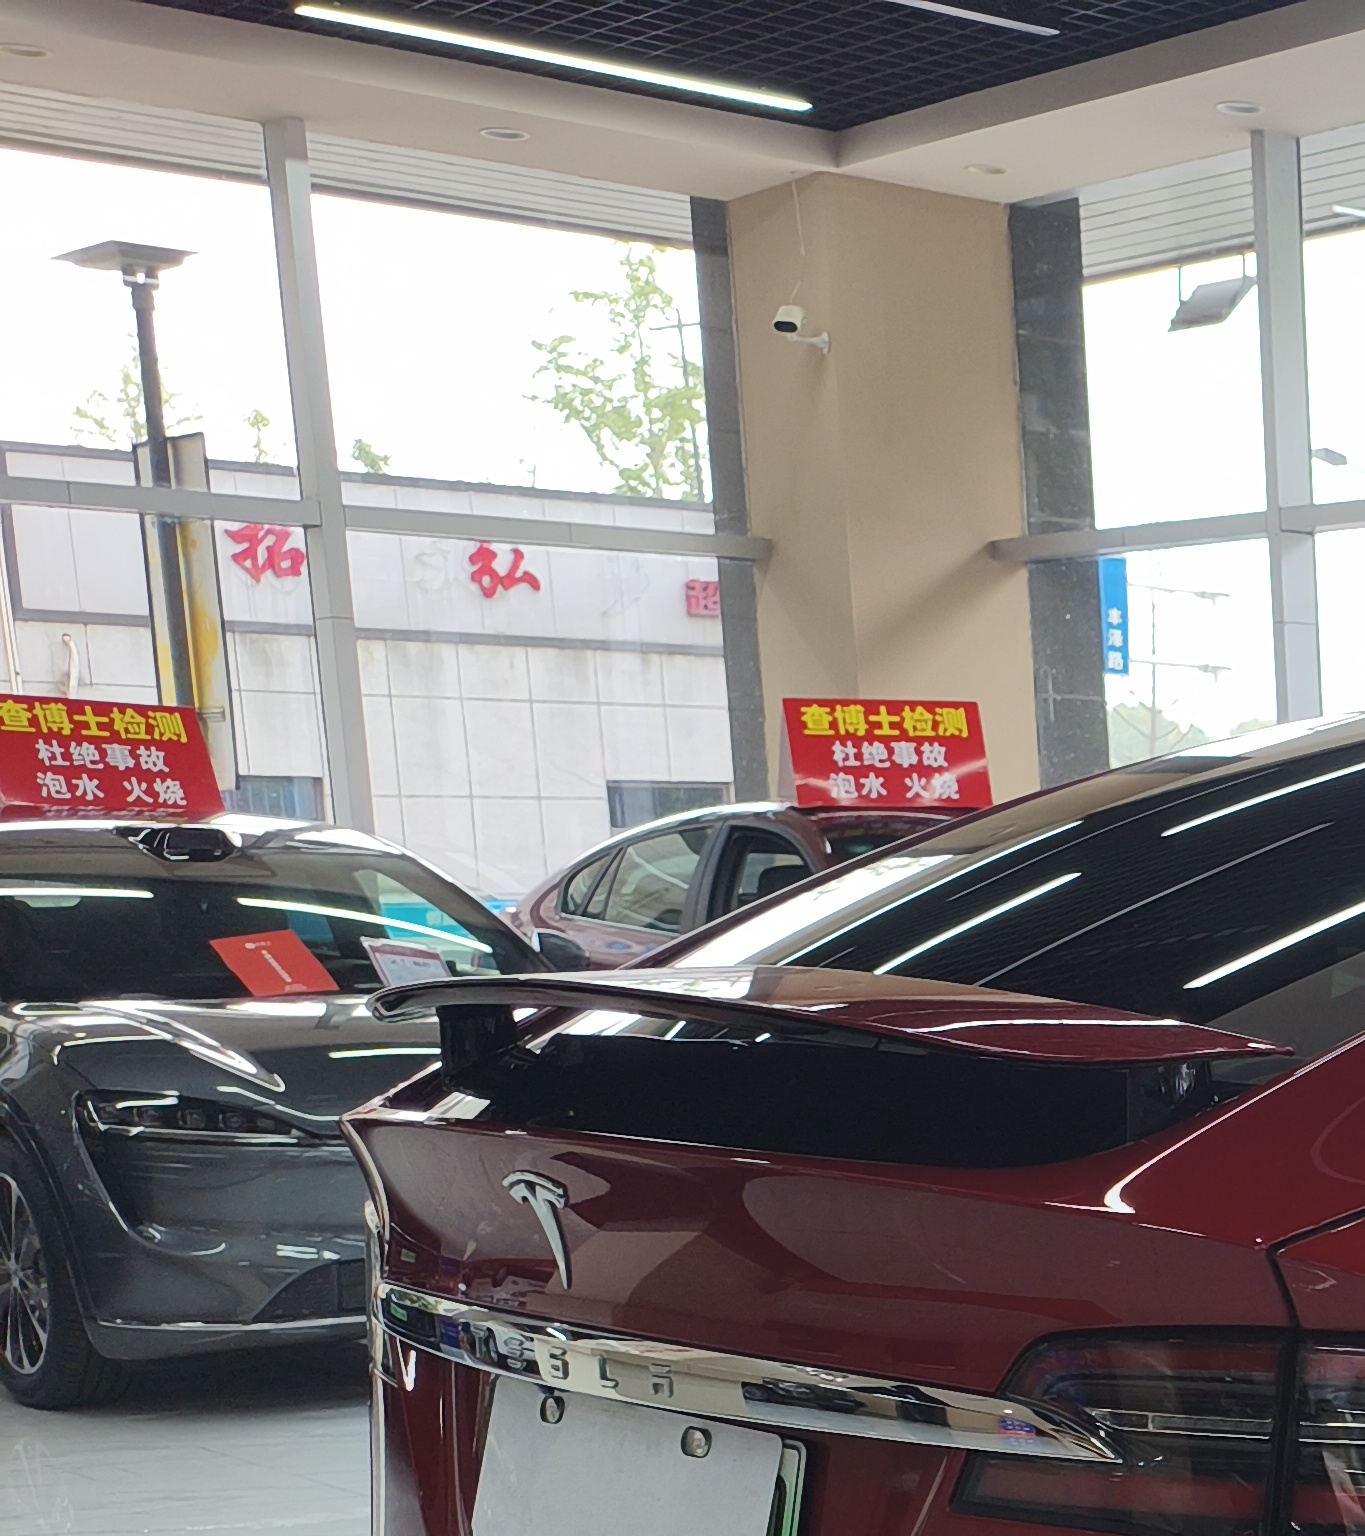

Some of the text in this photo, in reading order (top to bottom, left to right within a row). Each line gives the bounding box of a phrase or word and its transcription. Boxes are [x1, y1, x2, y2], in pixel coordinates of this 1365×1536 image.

[0, 699, 188, 743] 查博士检测
[800, 704, 969, 738] 查博士检测
[35, 738, 170, 773] 杜绝事故
[831, 739, 948, 769] 杜绝事故
[36, 771, 188, 806] 泡水 火烧
[829, 771, 960, 800] 泡水 火烧
